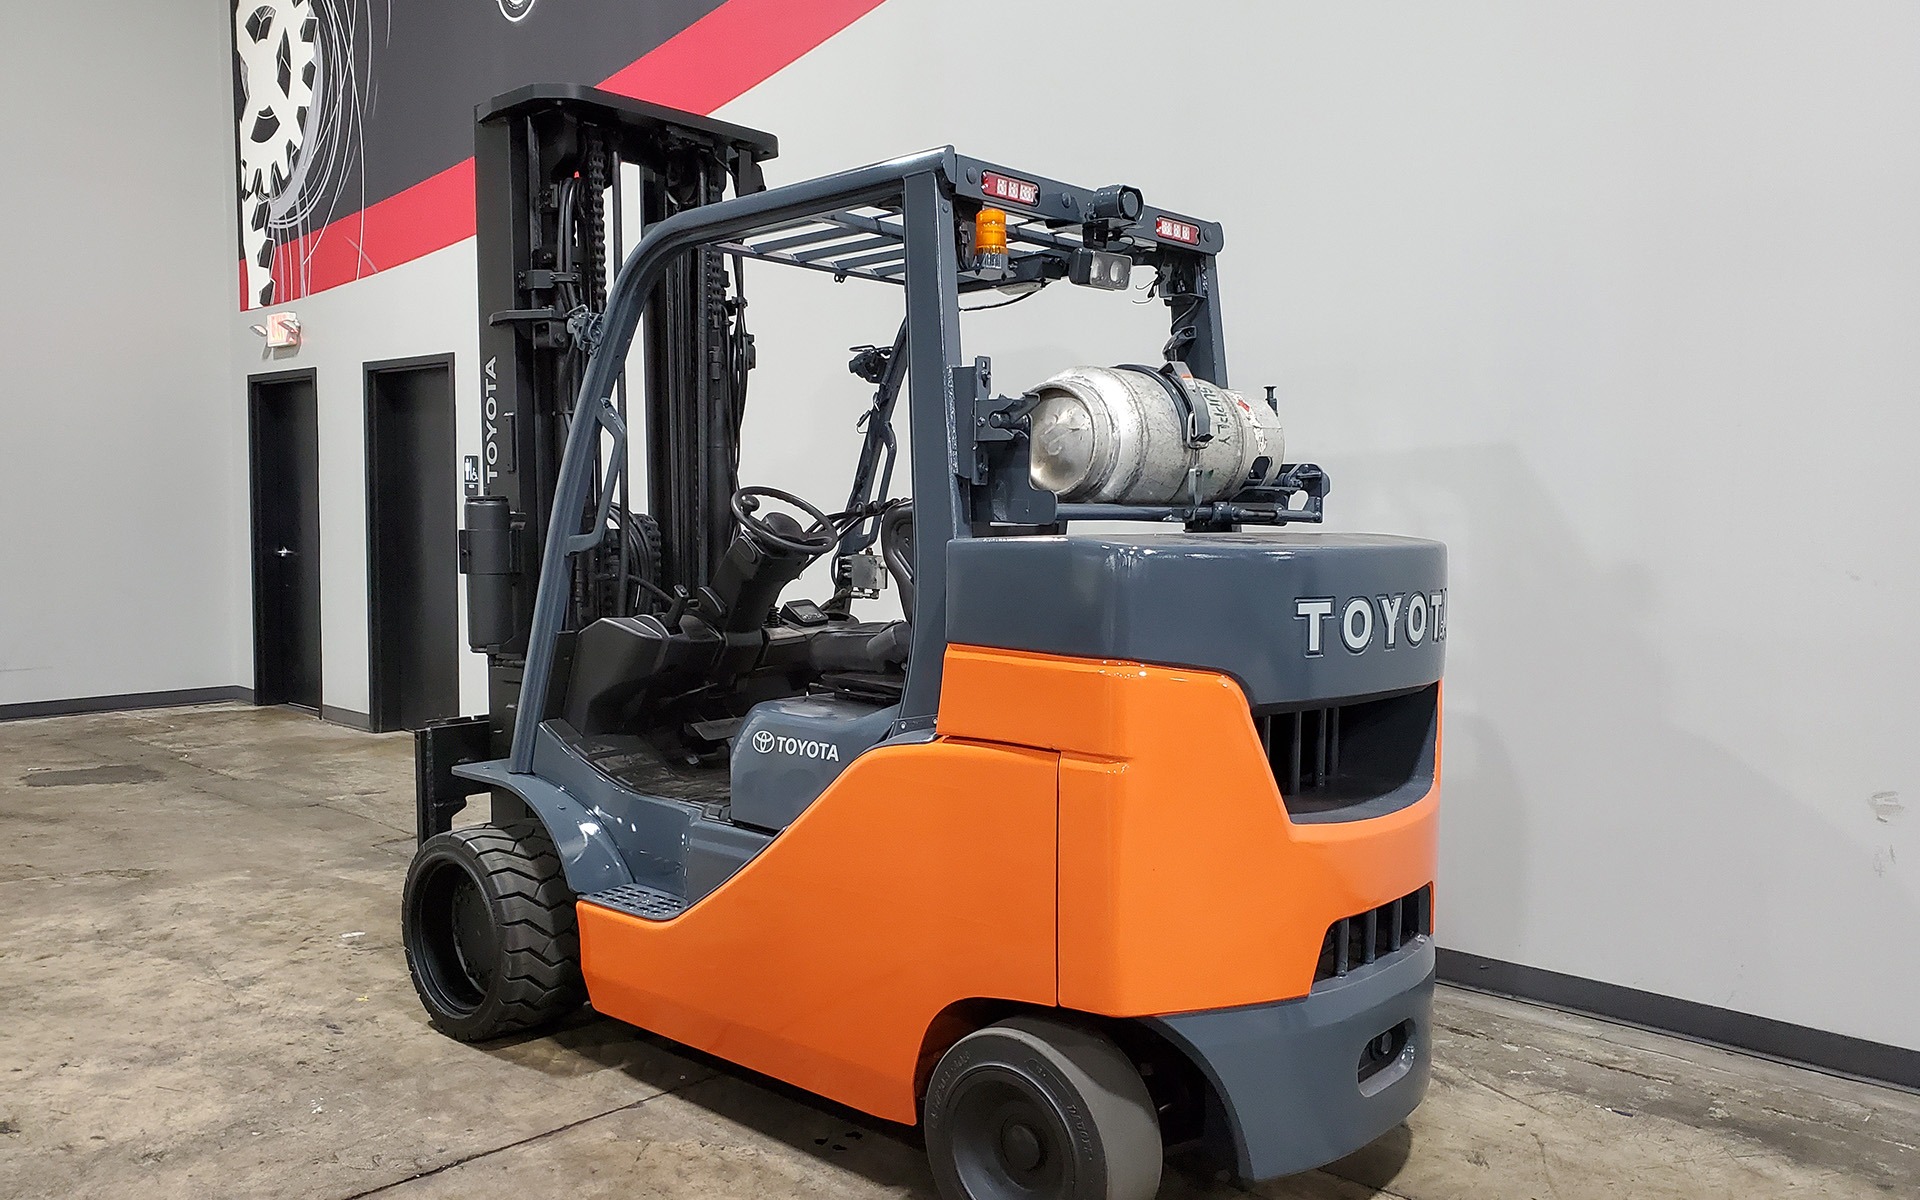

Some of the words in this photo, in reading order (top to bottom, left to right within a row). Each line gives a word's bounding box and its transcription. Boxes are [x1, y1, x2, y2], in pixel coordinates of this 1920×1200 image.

[485, 356, 498, 484] TOYOTA
[1200, 387, 1232, 447] SUPPLY
[1296, 588, 1447, 656] TOYOT
[776, 736, 840, 762] TOYOTA
